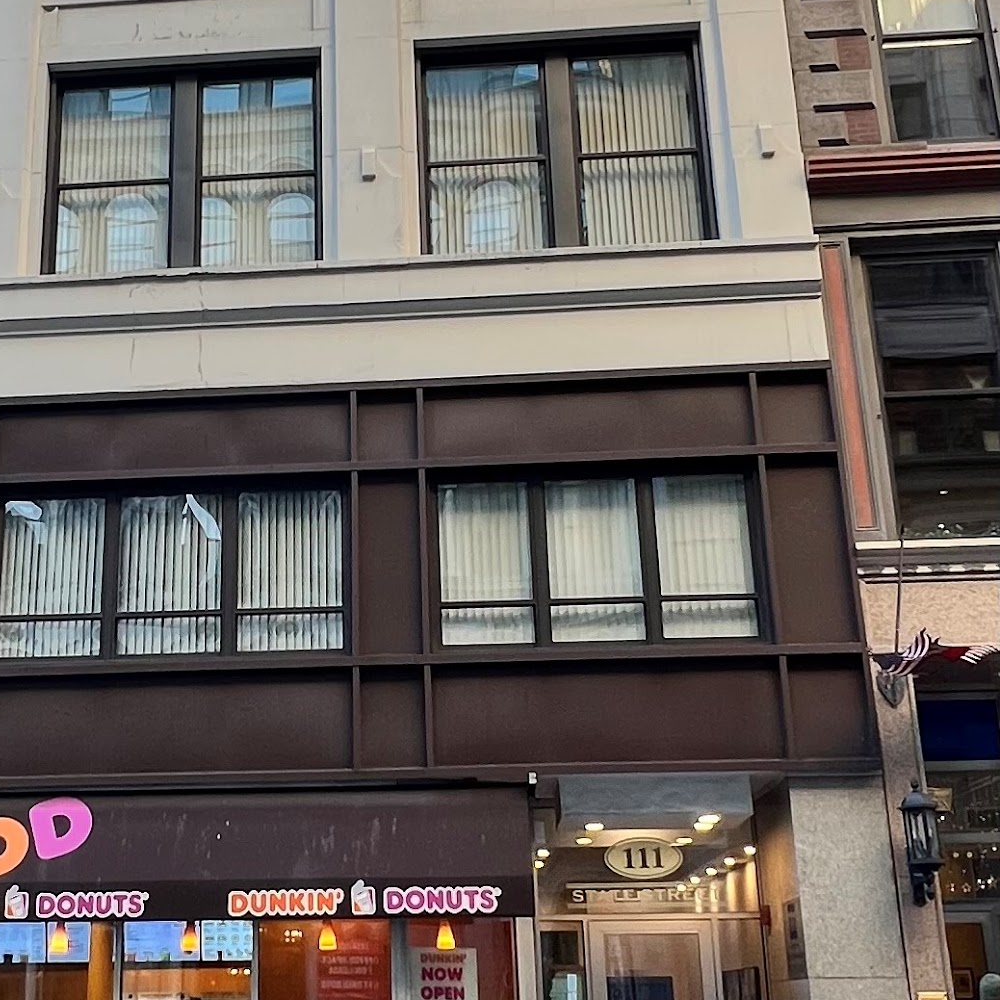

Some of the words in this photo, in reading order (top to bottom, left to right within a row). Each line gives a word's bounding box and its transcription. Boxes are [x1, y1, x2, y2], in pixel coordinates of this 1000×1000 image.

[623, 847, 664, 869] 111
[36, 892, 146, 916] DONUTS
[229, 888, 343, 914] DUNKIN'
[385, 887, 497, 912] DONUTS
[421, 966, 463, 981] NOW
[420, 985, 465, 1000] OPEN
